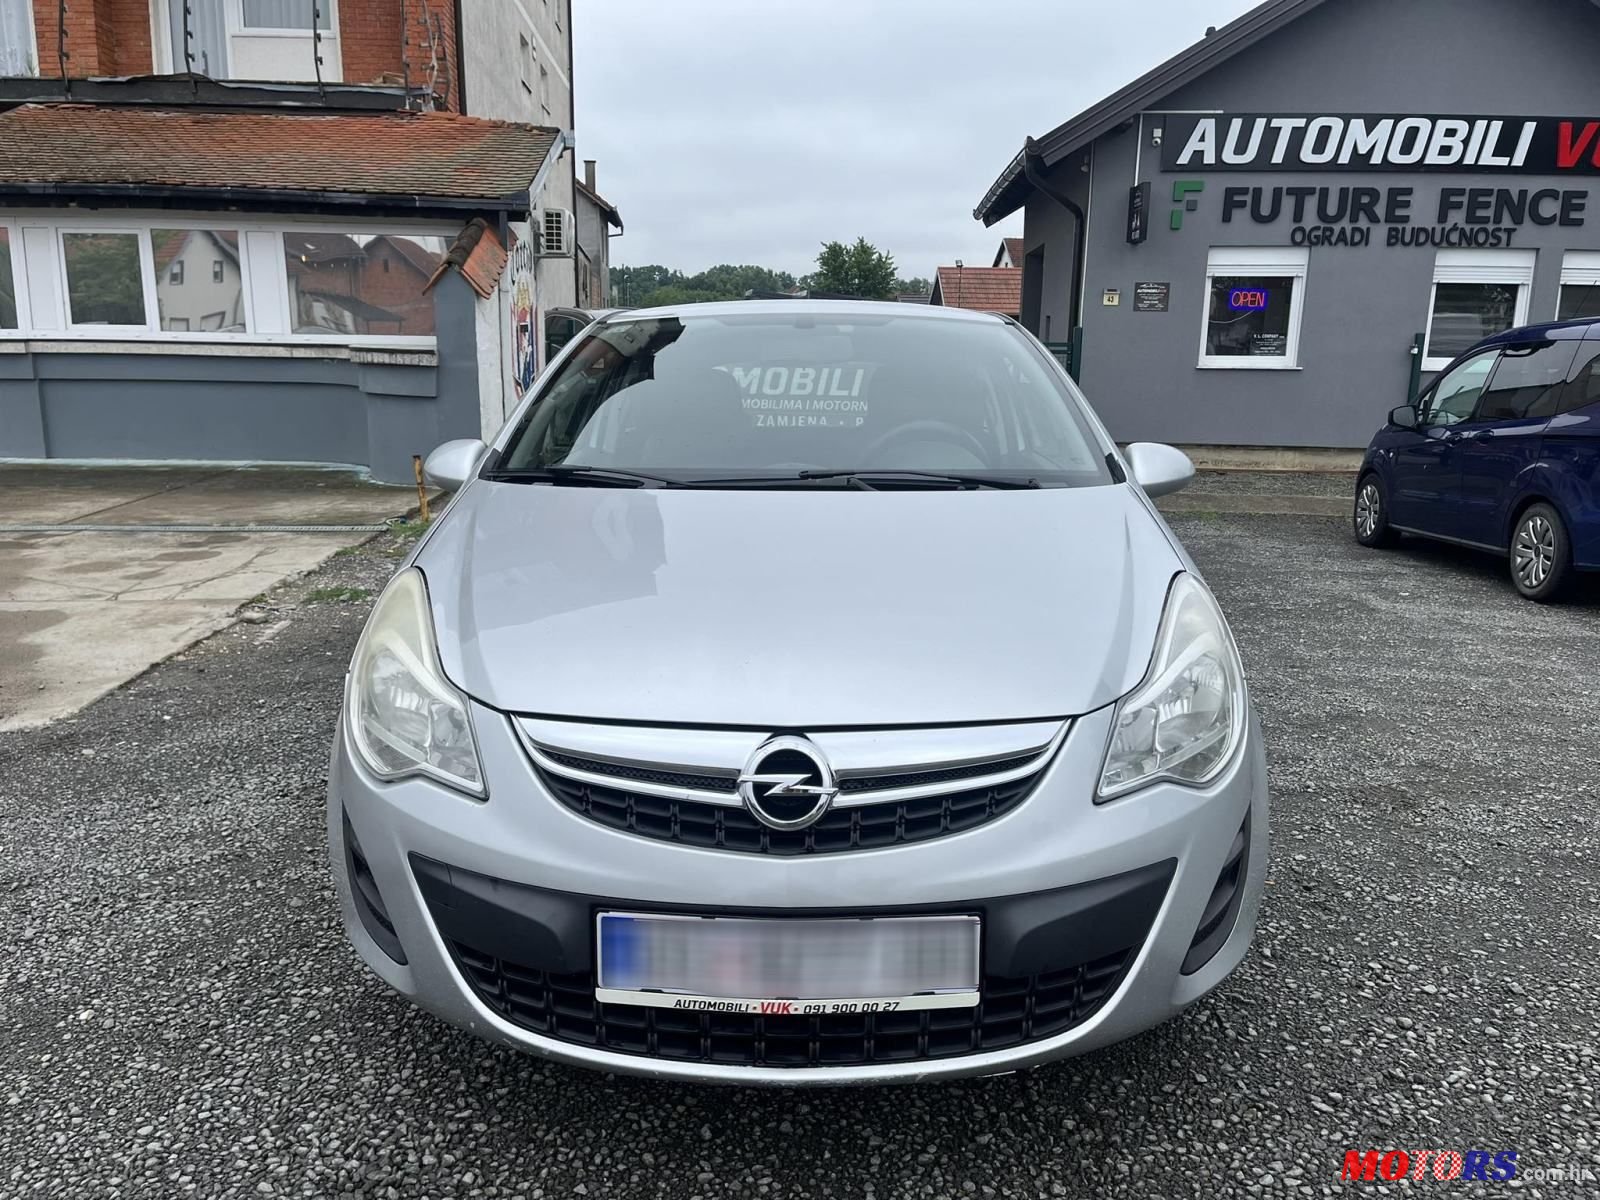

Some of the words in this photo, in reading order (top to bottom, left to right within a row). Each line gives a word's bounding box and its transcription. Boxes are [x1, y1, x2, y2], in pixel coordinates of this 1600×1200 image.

[1175, 116, 1538, 168] AUTOMOBILI
[1556, 121, 1600, 168] V
[1221, 186, 1413, 225] FUTURE
[1437, 187, 1588, 226] FENCE
[1290, 226, 1371, 247] OGRADI
[1386, 223, 1517, 248] BUDUĆNOST
[1231, 291, 1265, 307] OPEN
[757, 415, 827, 427] ZAMJENA
[674, 999, 750, 1013] AUTOMOBILI
[760, 1001, 792, 1014] VUK
[803, 1004, 827, 1015] 091
[831, 1003, 858, 1014] 900
[861, 1002, 879, 1013] 00
[882, 1001, 900, 1012] 27
